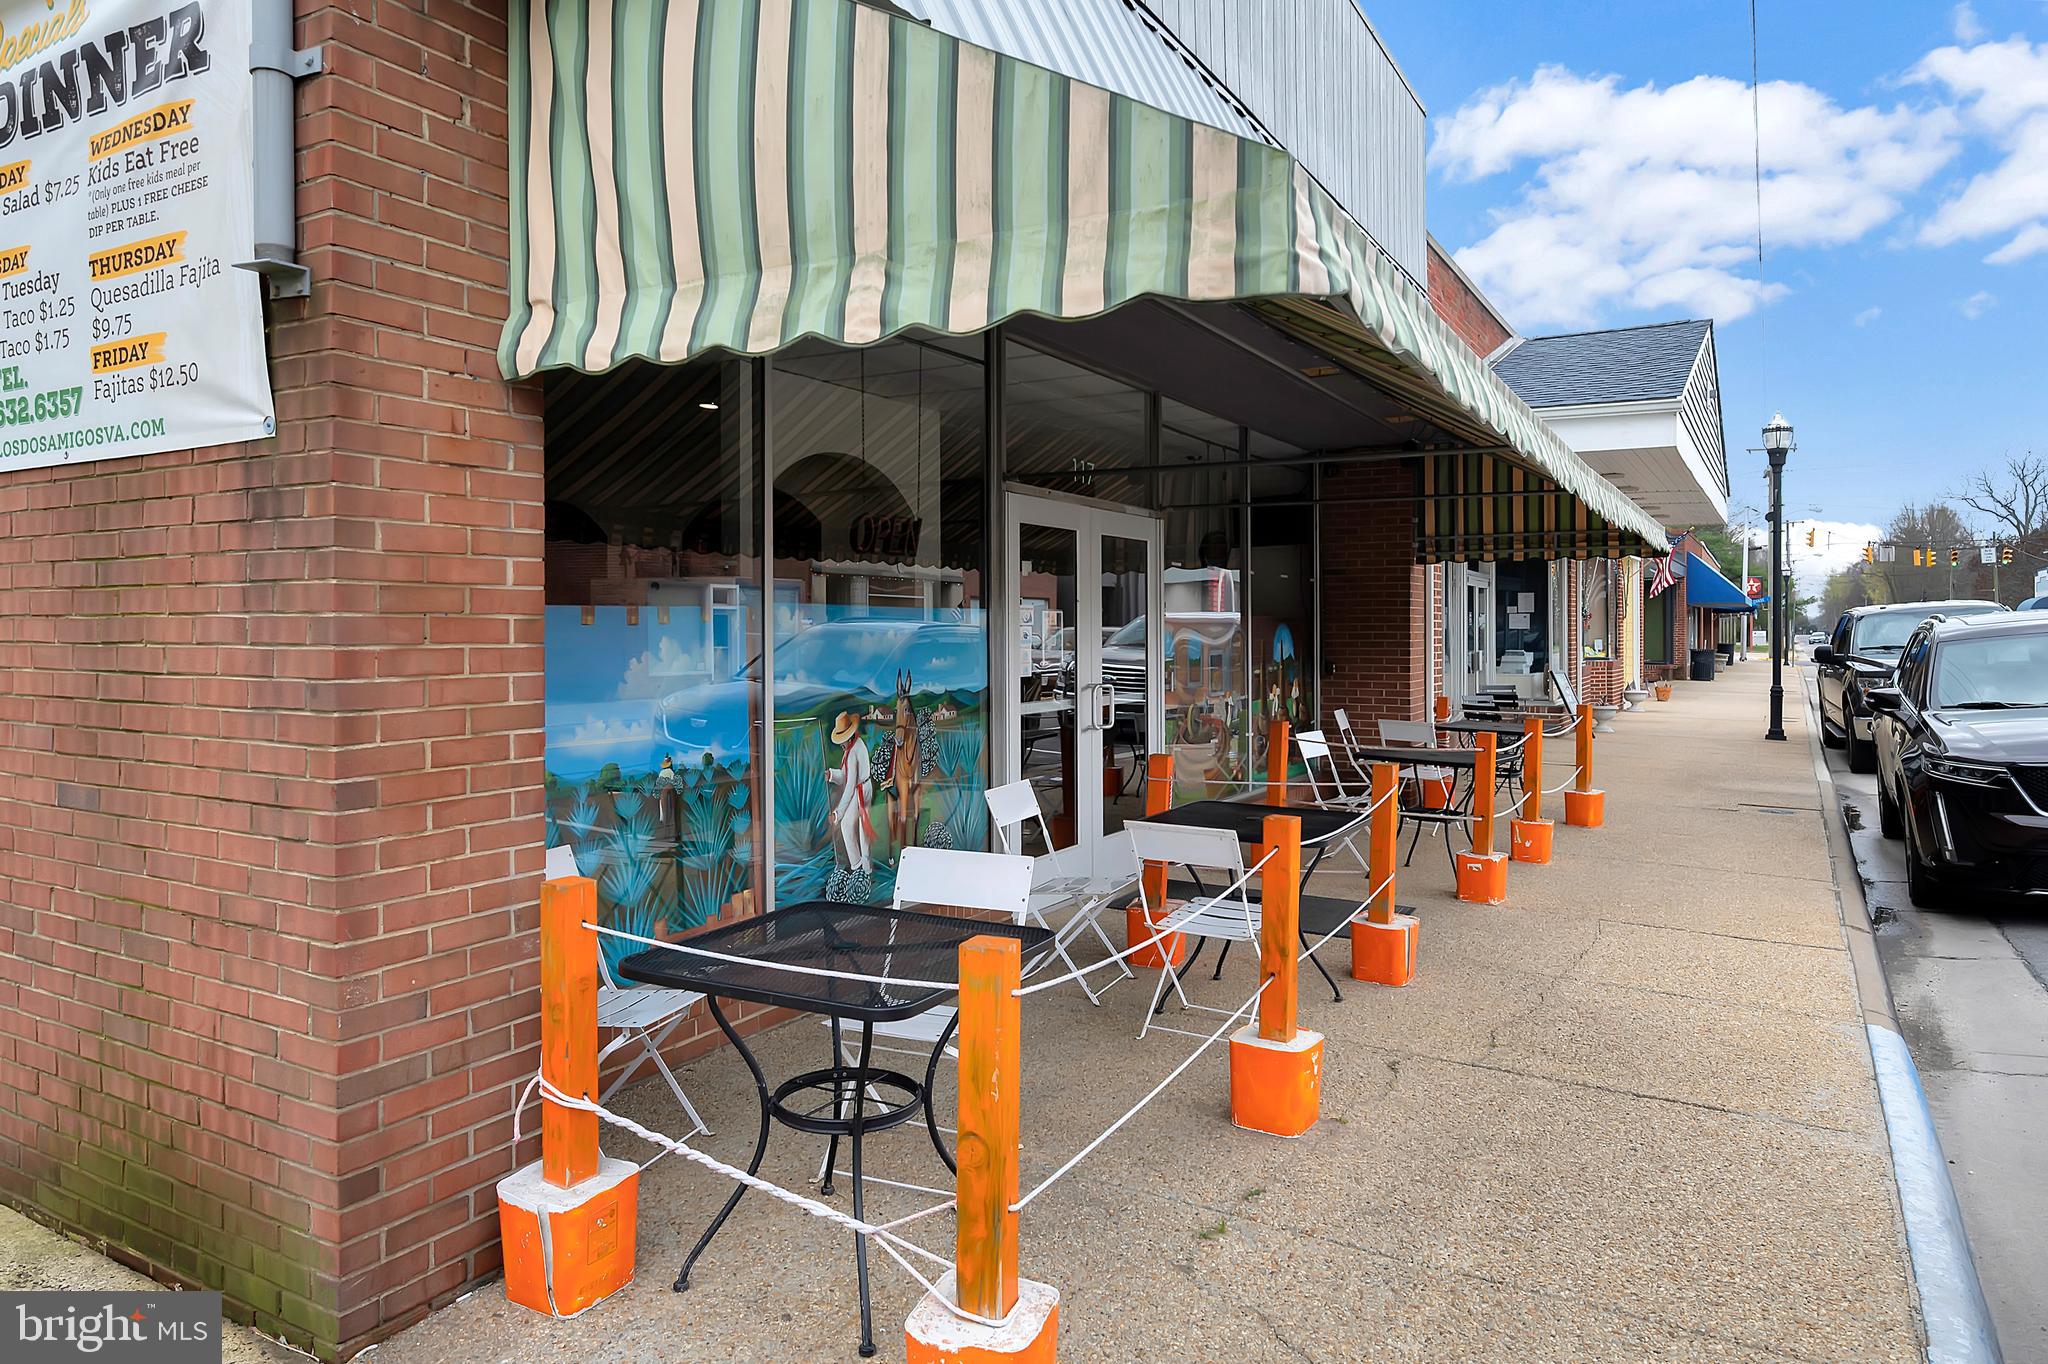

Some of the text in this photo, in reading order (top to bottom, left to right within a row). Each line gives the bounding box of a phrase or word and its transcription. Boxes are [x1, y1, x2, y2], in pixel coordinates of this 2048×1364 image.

[0, 0, 90, 72] pecials
[90, 104, 192, 157] WEDNESDAY
[88, 137, 200, 187] Kids Eat Free
[112, 183, 126, 196] one
[128, 178, 144, 190] free
[146, 170, 163, 186] kids
[165, 162, 185, 180] meal
[187, 161, 201, 176] per
[2, 175, 80, 215] Salad $7.25
[88, 175, 209, 221] table) PLUS 1 FREE CHEESE
[89, 210, 159, 239] DIP PER TABLE.
[89, 239, 177, 277] THURSDAY
[2, 269, 60, 301] Tuesday
[90, 256, 221, 313] Quesadilla Fajita
[3, 296, 75, 329] Taco $1.25
[92, 313, 133, 342] $9.75
[0, 328, 70, 359] Taco $1.75
[93, 342, 149, 369] FRIDAY
[94, 362, 199, 404] Fajitas $12.50
[1073, 458, 1095, 485] 117
[849, 513, 922, 557] OPEN
